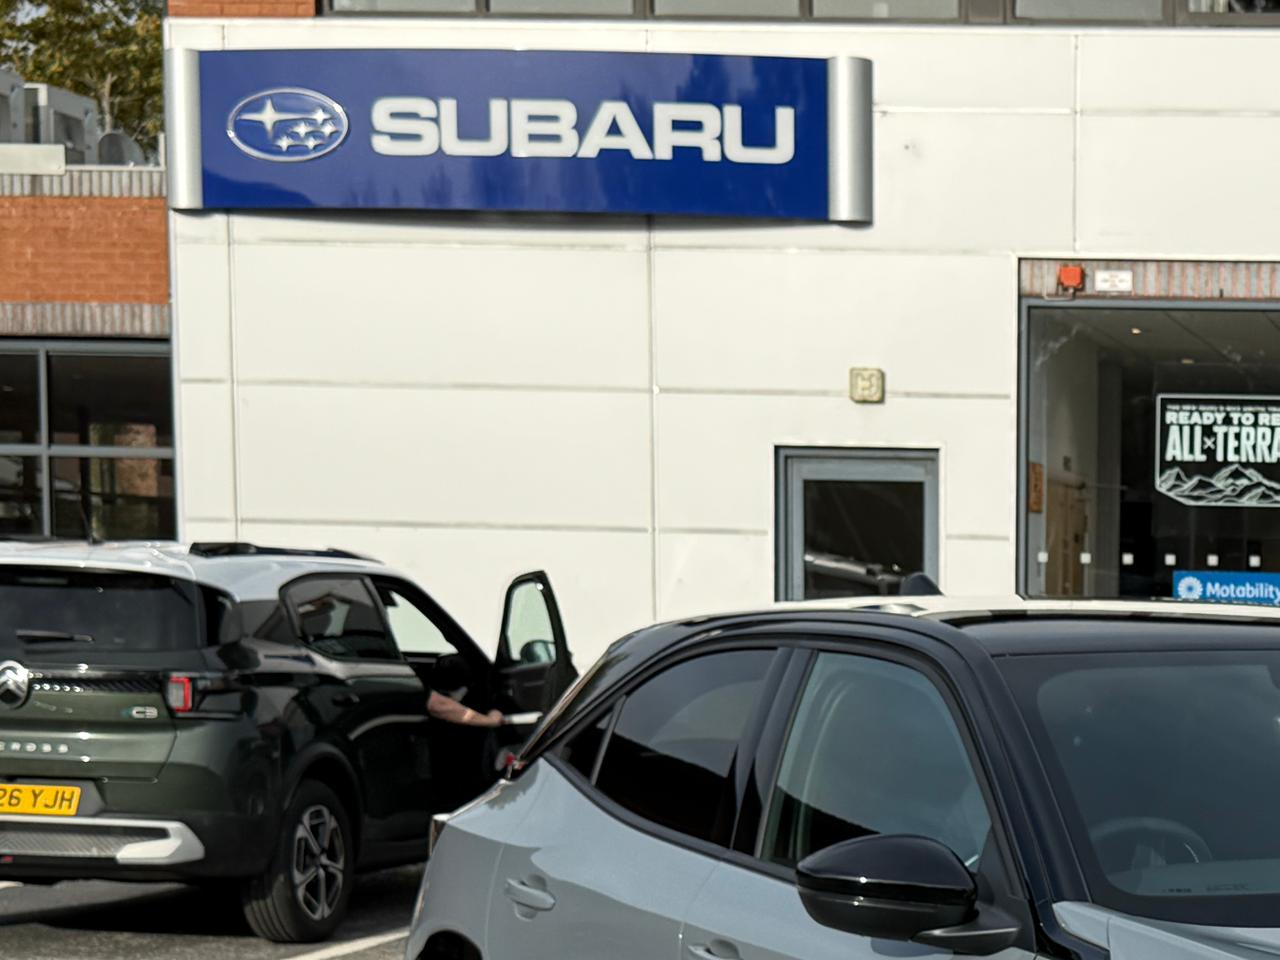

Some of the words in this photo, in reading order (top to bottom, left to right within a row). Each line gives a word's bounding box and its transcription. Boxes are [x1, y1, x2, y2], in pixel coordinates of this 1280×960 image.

[371, 97, 796, 165] SUBARU
[1165, 411, 1226, 426] READY
[1228, 412, 1255, 426] TO
[31, 789, 75, 810] YJH
